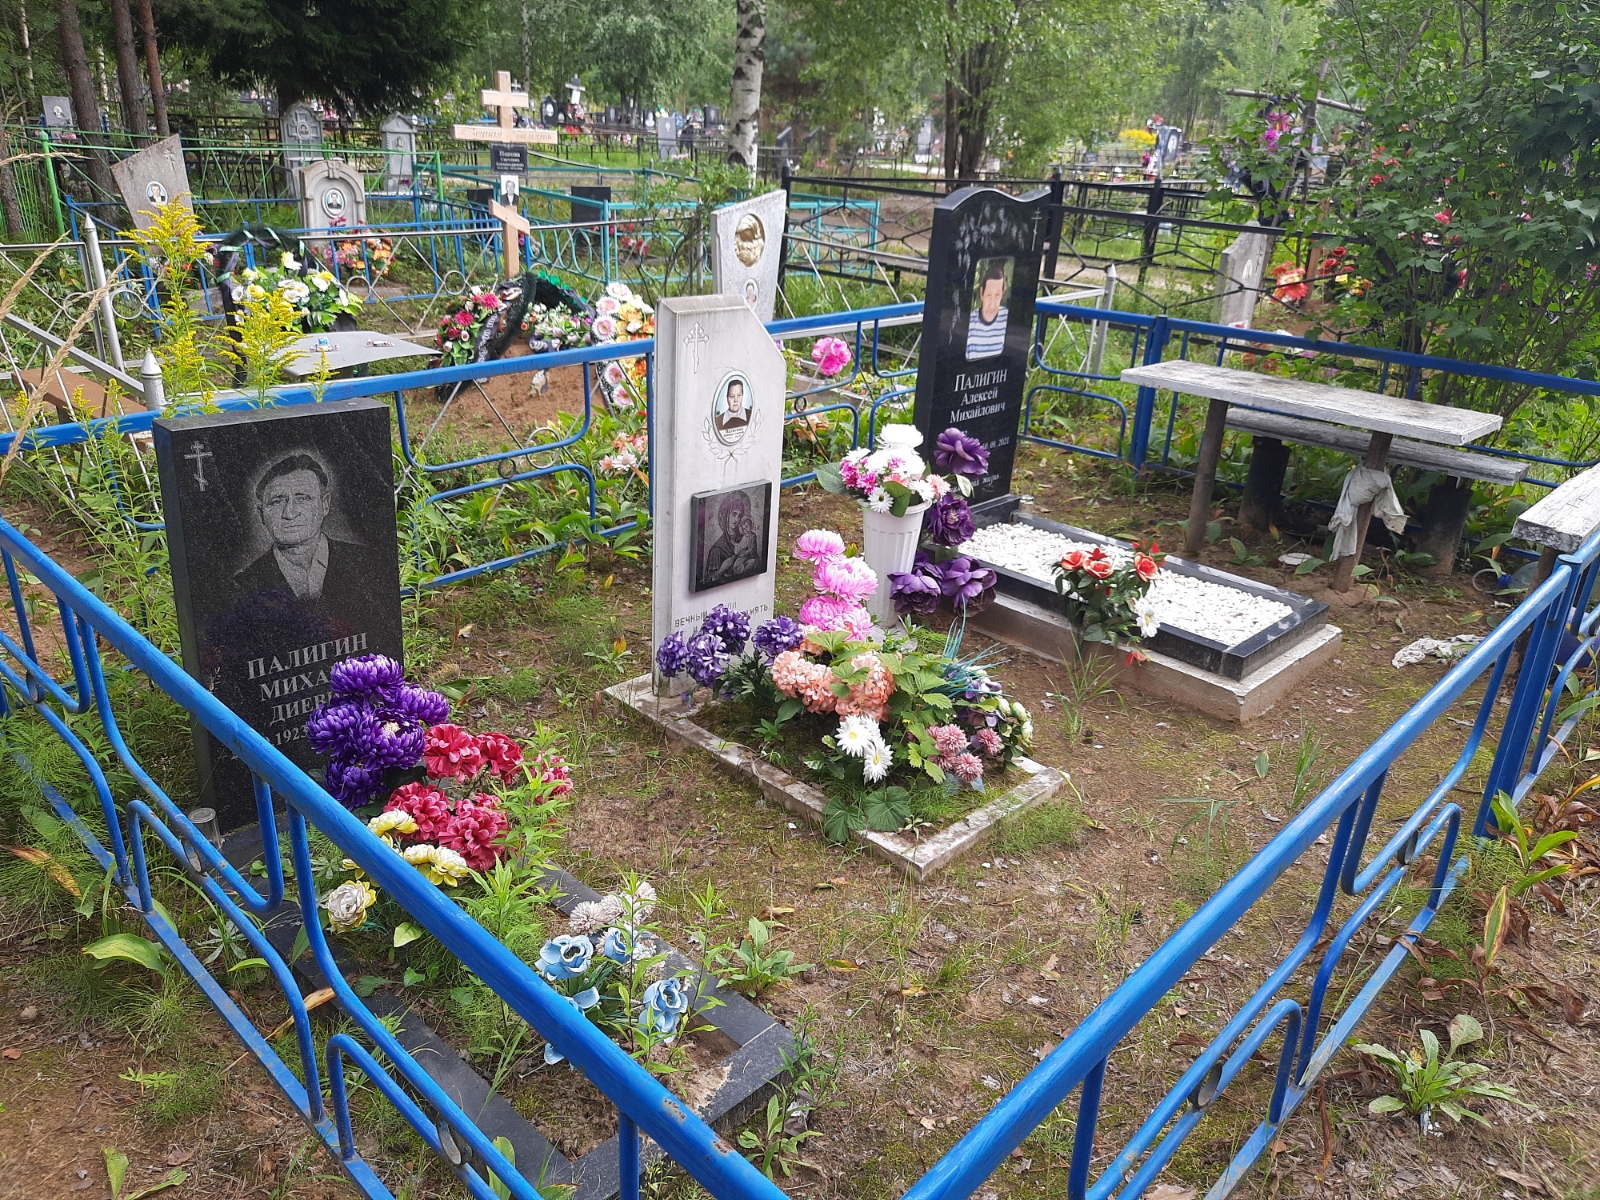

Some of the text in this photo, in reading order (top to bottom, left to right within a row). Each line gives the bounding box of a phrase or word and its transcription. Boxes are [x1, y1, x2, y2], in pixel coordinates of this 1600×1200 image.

[954, 369, 1008, 392] ПАЛИГИН
[960, 386, 998, 406] Алексей
[949, 402, 1006, 424] Михайлович
[247, 632, 368, 680] ПАЛИГИН
[260, 666, 335, 702] МИХА
